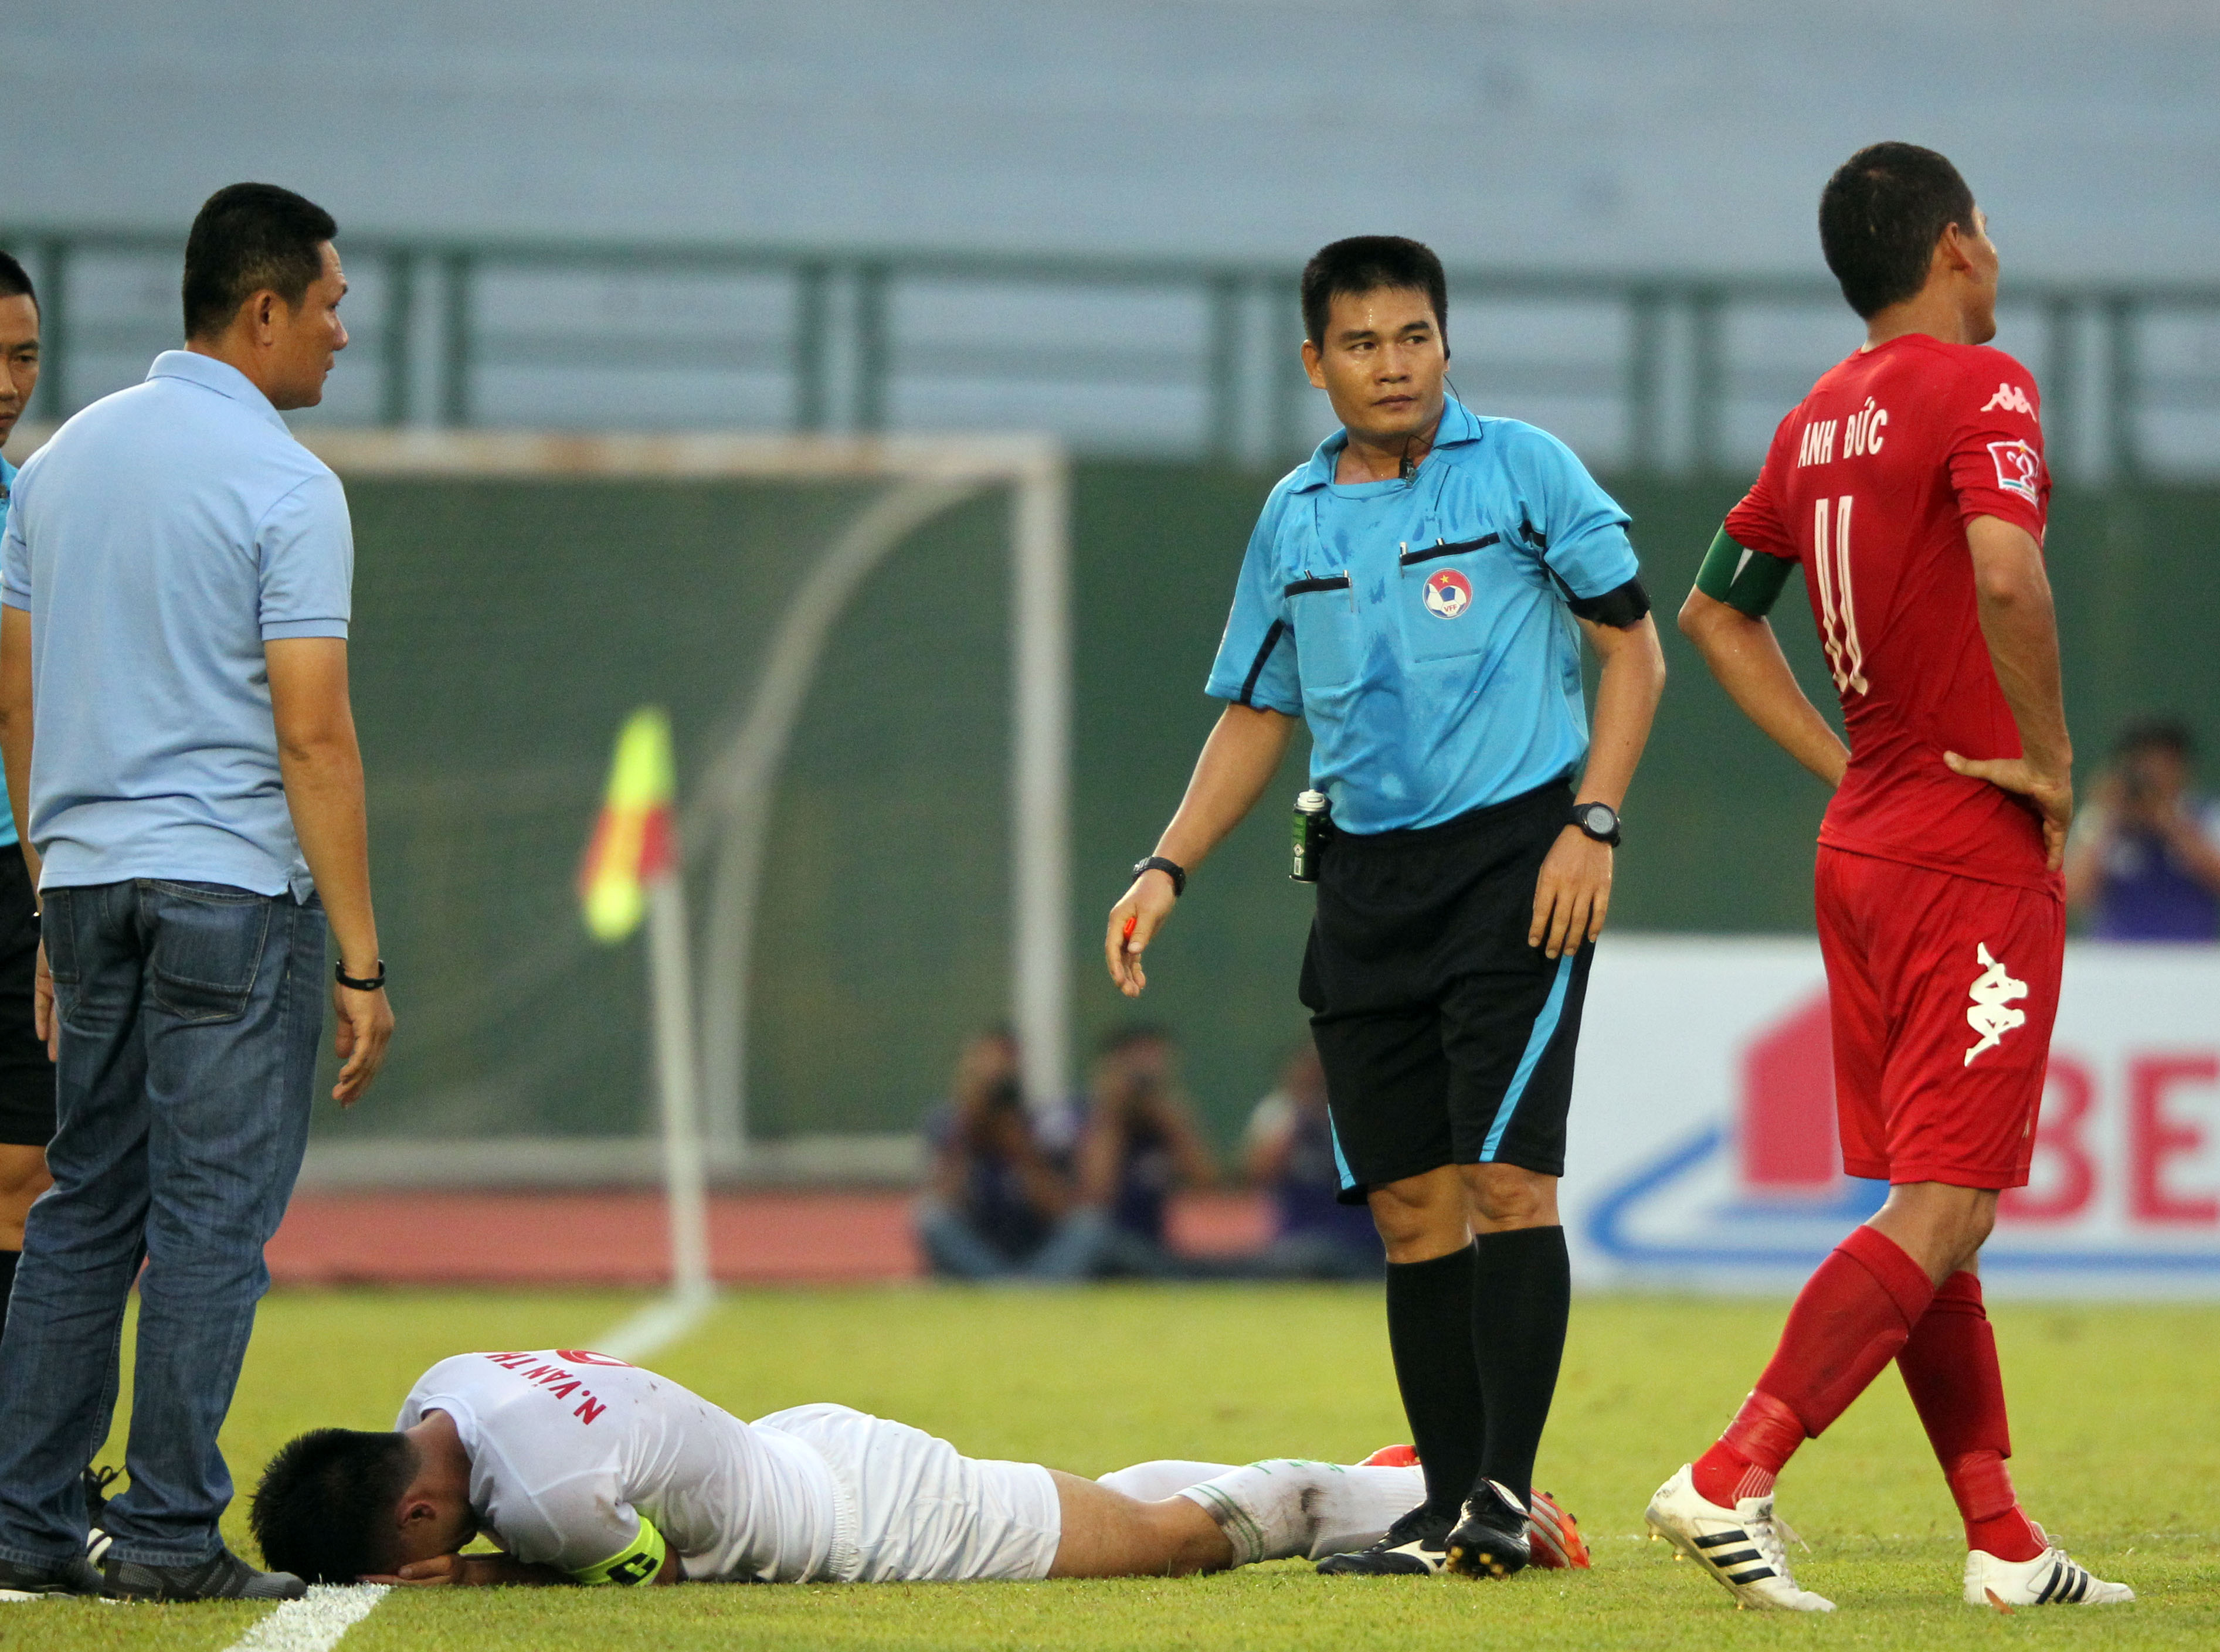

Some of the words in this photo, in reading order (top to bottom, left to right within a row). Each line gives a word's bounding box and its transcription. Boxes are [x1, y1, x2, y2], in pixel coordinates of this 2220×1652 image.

[1797, 419, 1838, 468] ANH
[1843, 396, 1888, 459] ĐỨC
[1444, 604, 1458, 612] VFF
[1814, 495, 1868, 696] 11
